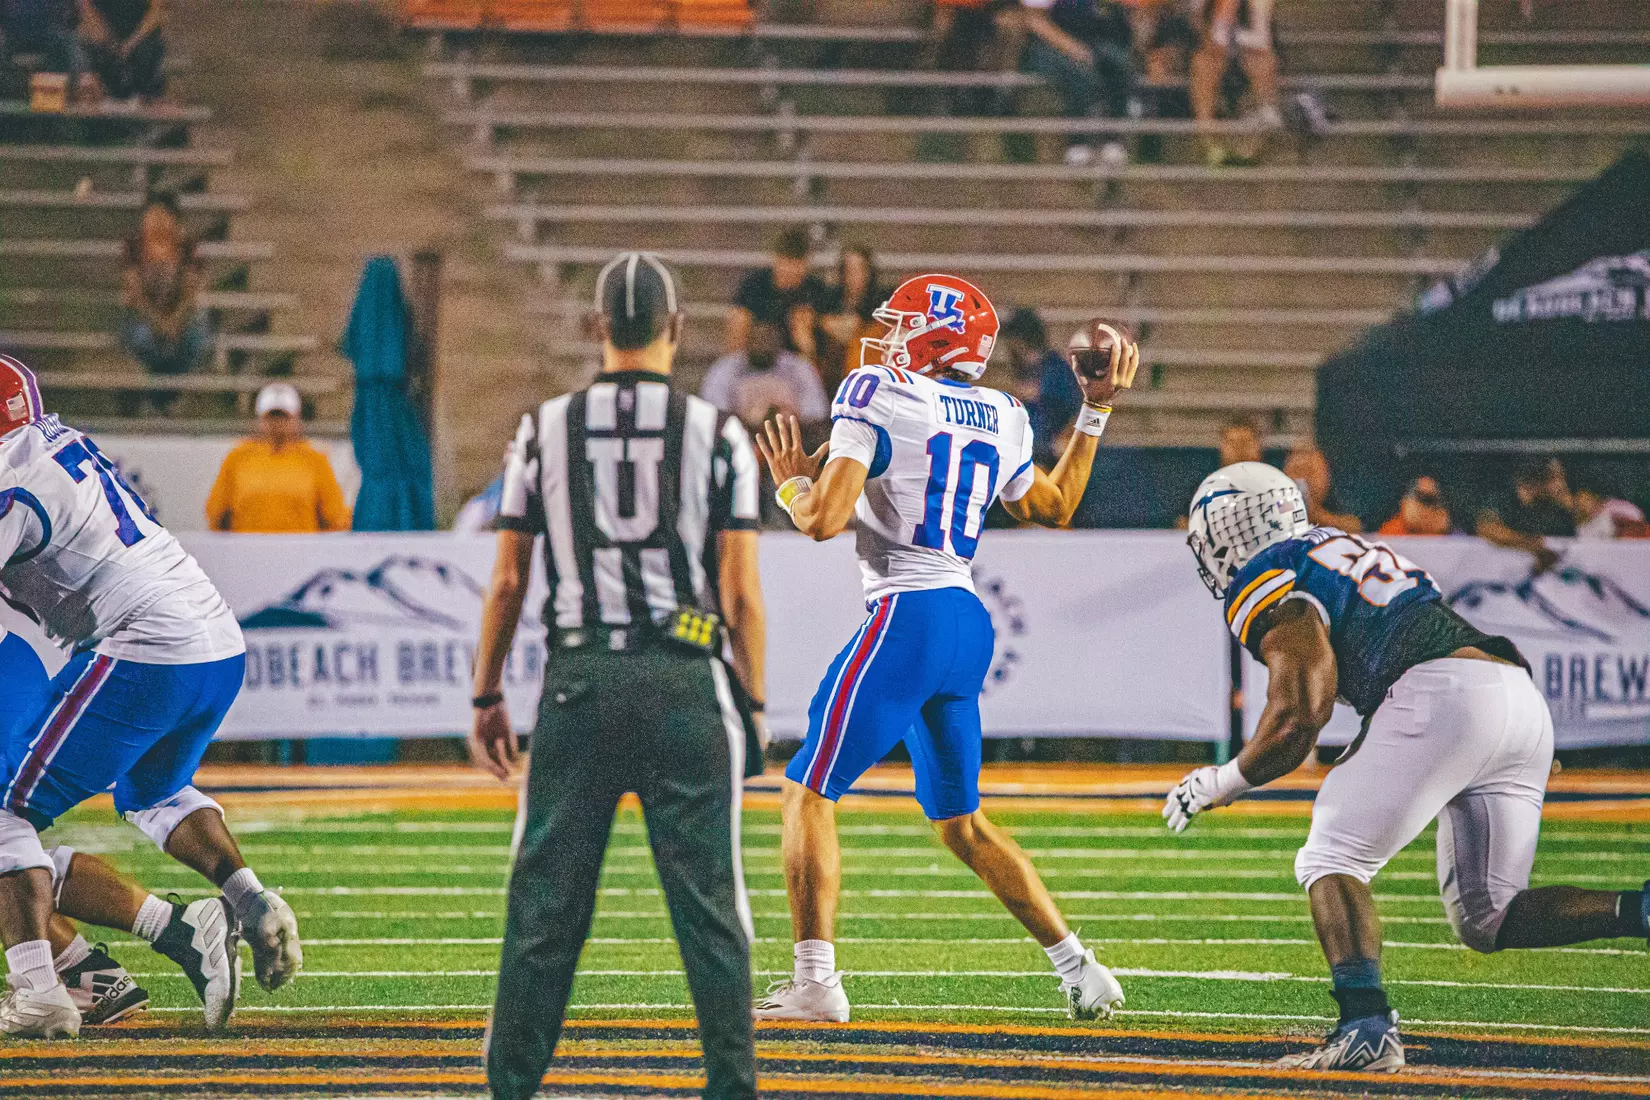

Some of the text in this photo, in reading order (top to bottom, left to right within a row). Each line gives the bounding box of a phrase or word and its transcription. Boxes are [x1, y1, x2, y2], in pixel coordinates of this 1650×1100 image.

[836, 372, 880, 409] 10
[939, 395, 999, 435] TURNER
[586, 437, 664, 542] U
[912, 431, 1000, 560] 10
[1544, 653, 1650, 703] BREW
